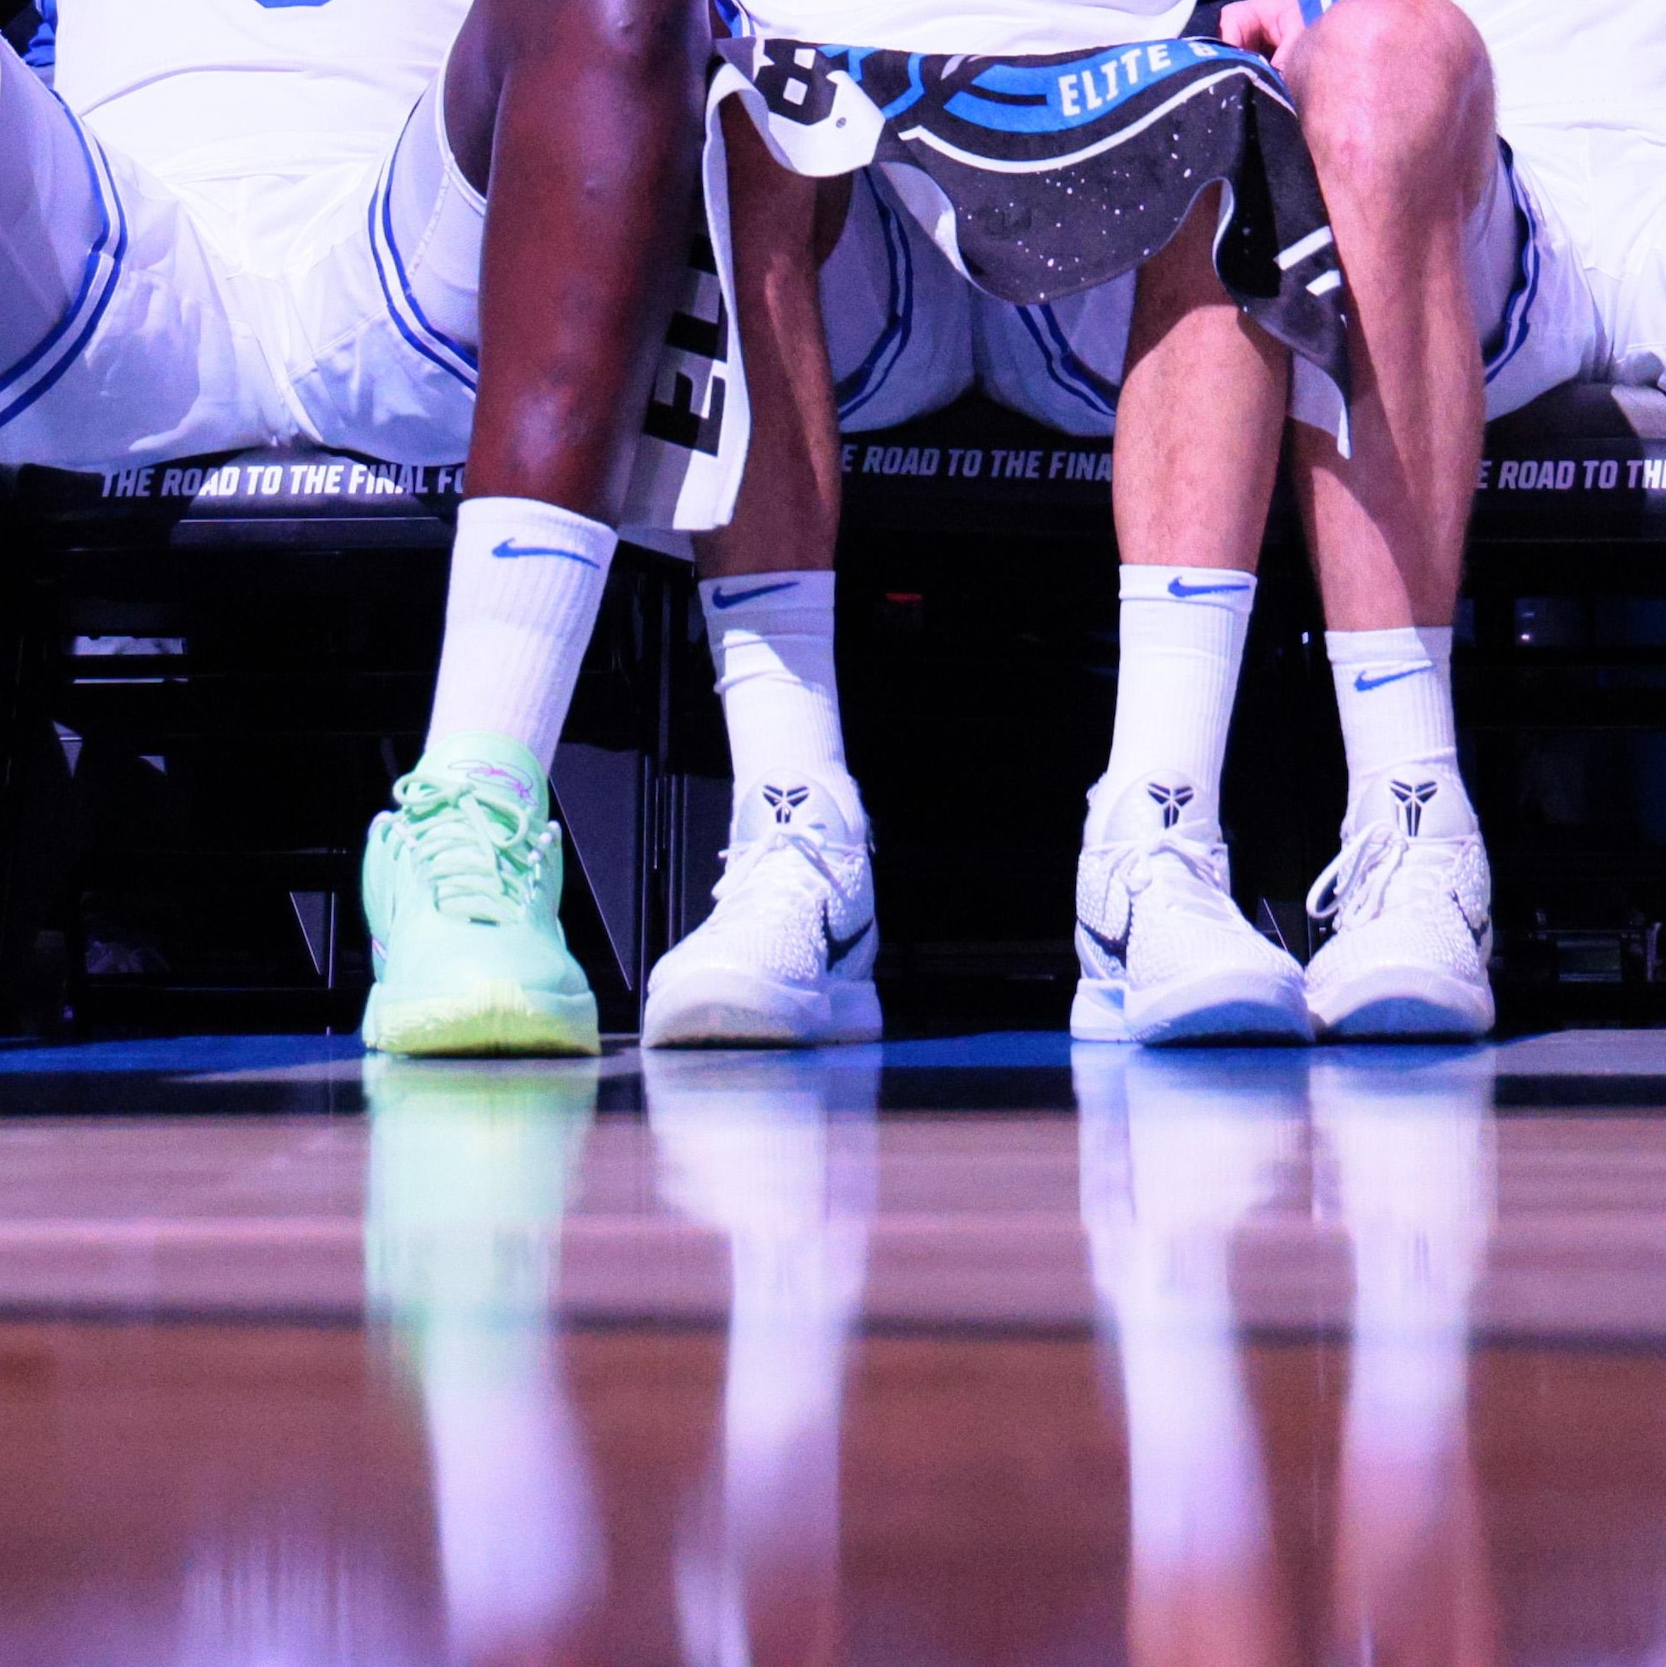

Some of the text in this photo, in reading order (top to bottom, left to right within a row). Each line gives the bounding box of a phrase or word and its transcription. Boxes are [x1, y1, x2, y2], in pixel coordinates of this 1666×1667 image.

[1057, 43, 1172, 118] ELITE
[861, 444, 941, 477] ROAD
[947, 447, 983, 478] TO
[990, 449, 1044, 480] THE
[1497, 460, 1575, 489] ROAD
[1582, 460, 1619, 489] TO
[101, 468, 154, 498] THE
[160, 466, 239, 497] ROAD
[247, 465, 284, 496] TO
[290, 465, 345, 495] THE
[348, 464, 429, 495] FINAL
